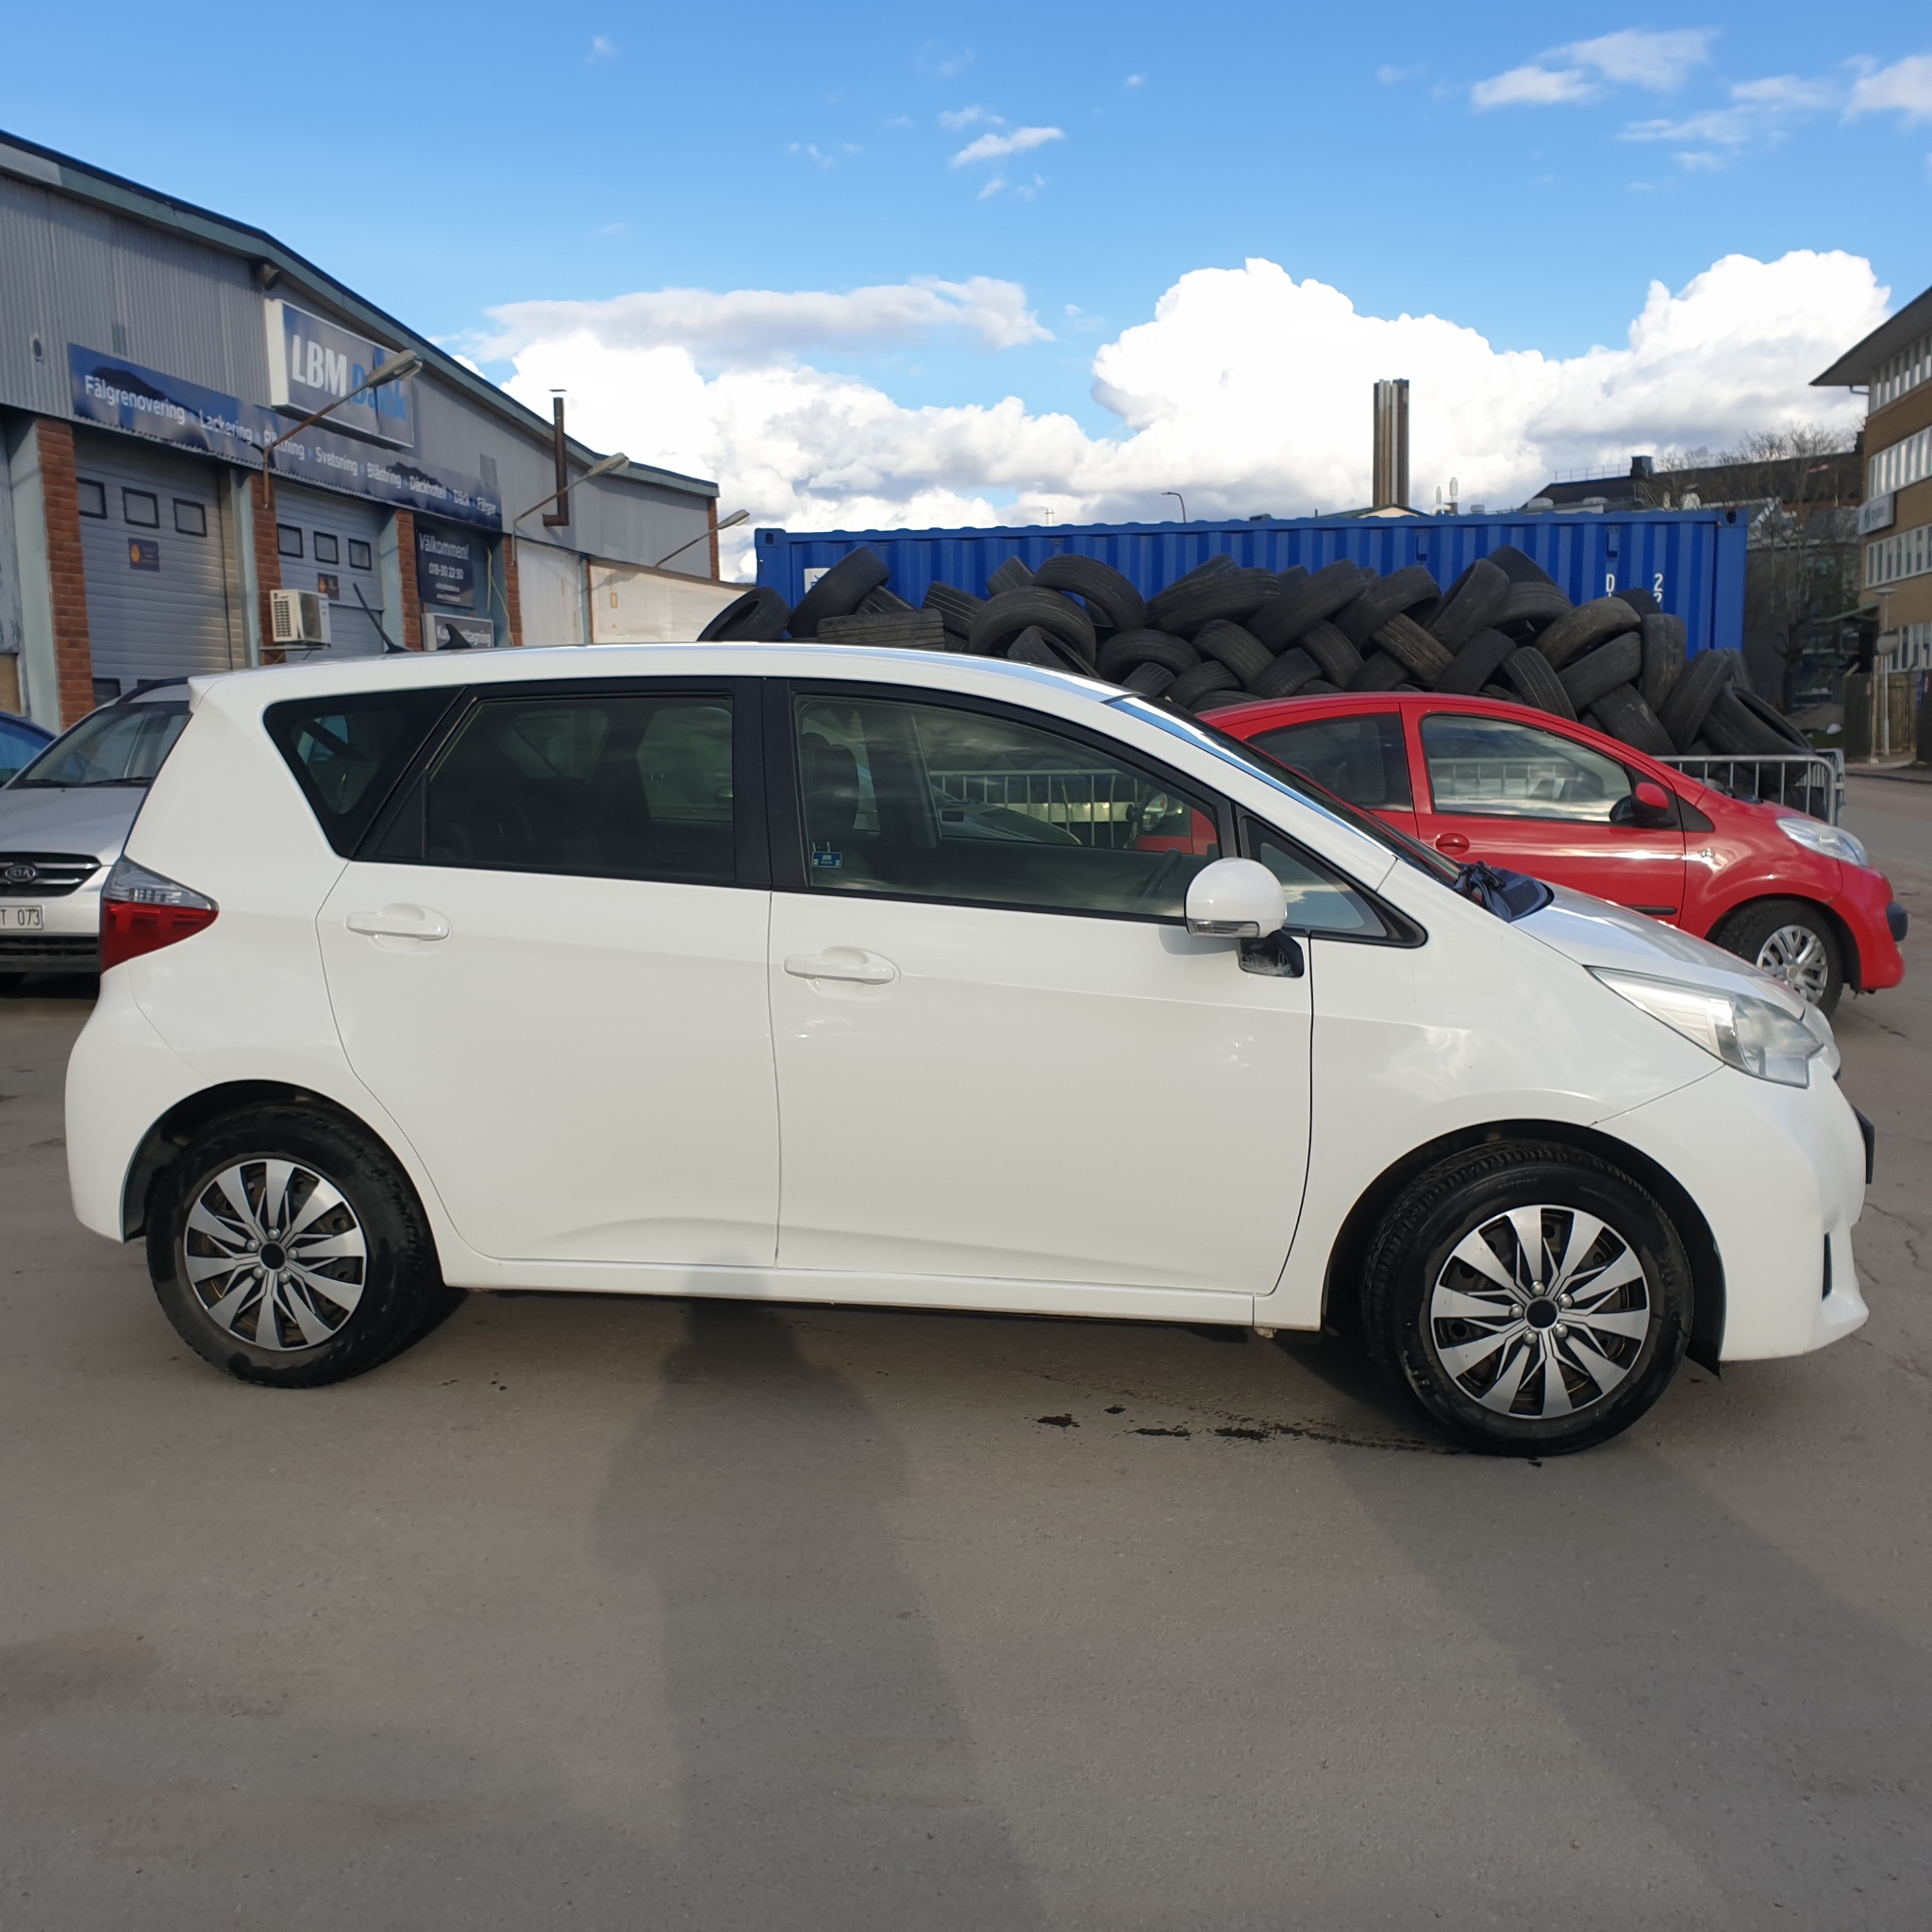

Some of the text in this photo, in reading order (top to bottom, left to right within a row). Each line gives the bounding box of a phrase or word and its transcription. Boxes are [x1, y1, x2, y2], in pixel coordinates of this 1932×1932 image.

[292, 334, 347, 397] LBM
[84, 375, 186, 425] Fälgrenovering
[199, 408, 253, 446] Lackering
[315, 445, 358, 476] Svetsning
[419, 532, 469, 560] Välkommen!
[10, 868, 31, 878] KIA
[17, 908, 41, 926] 073
